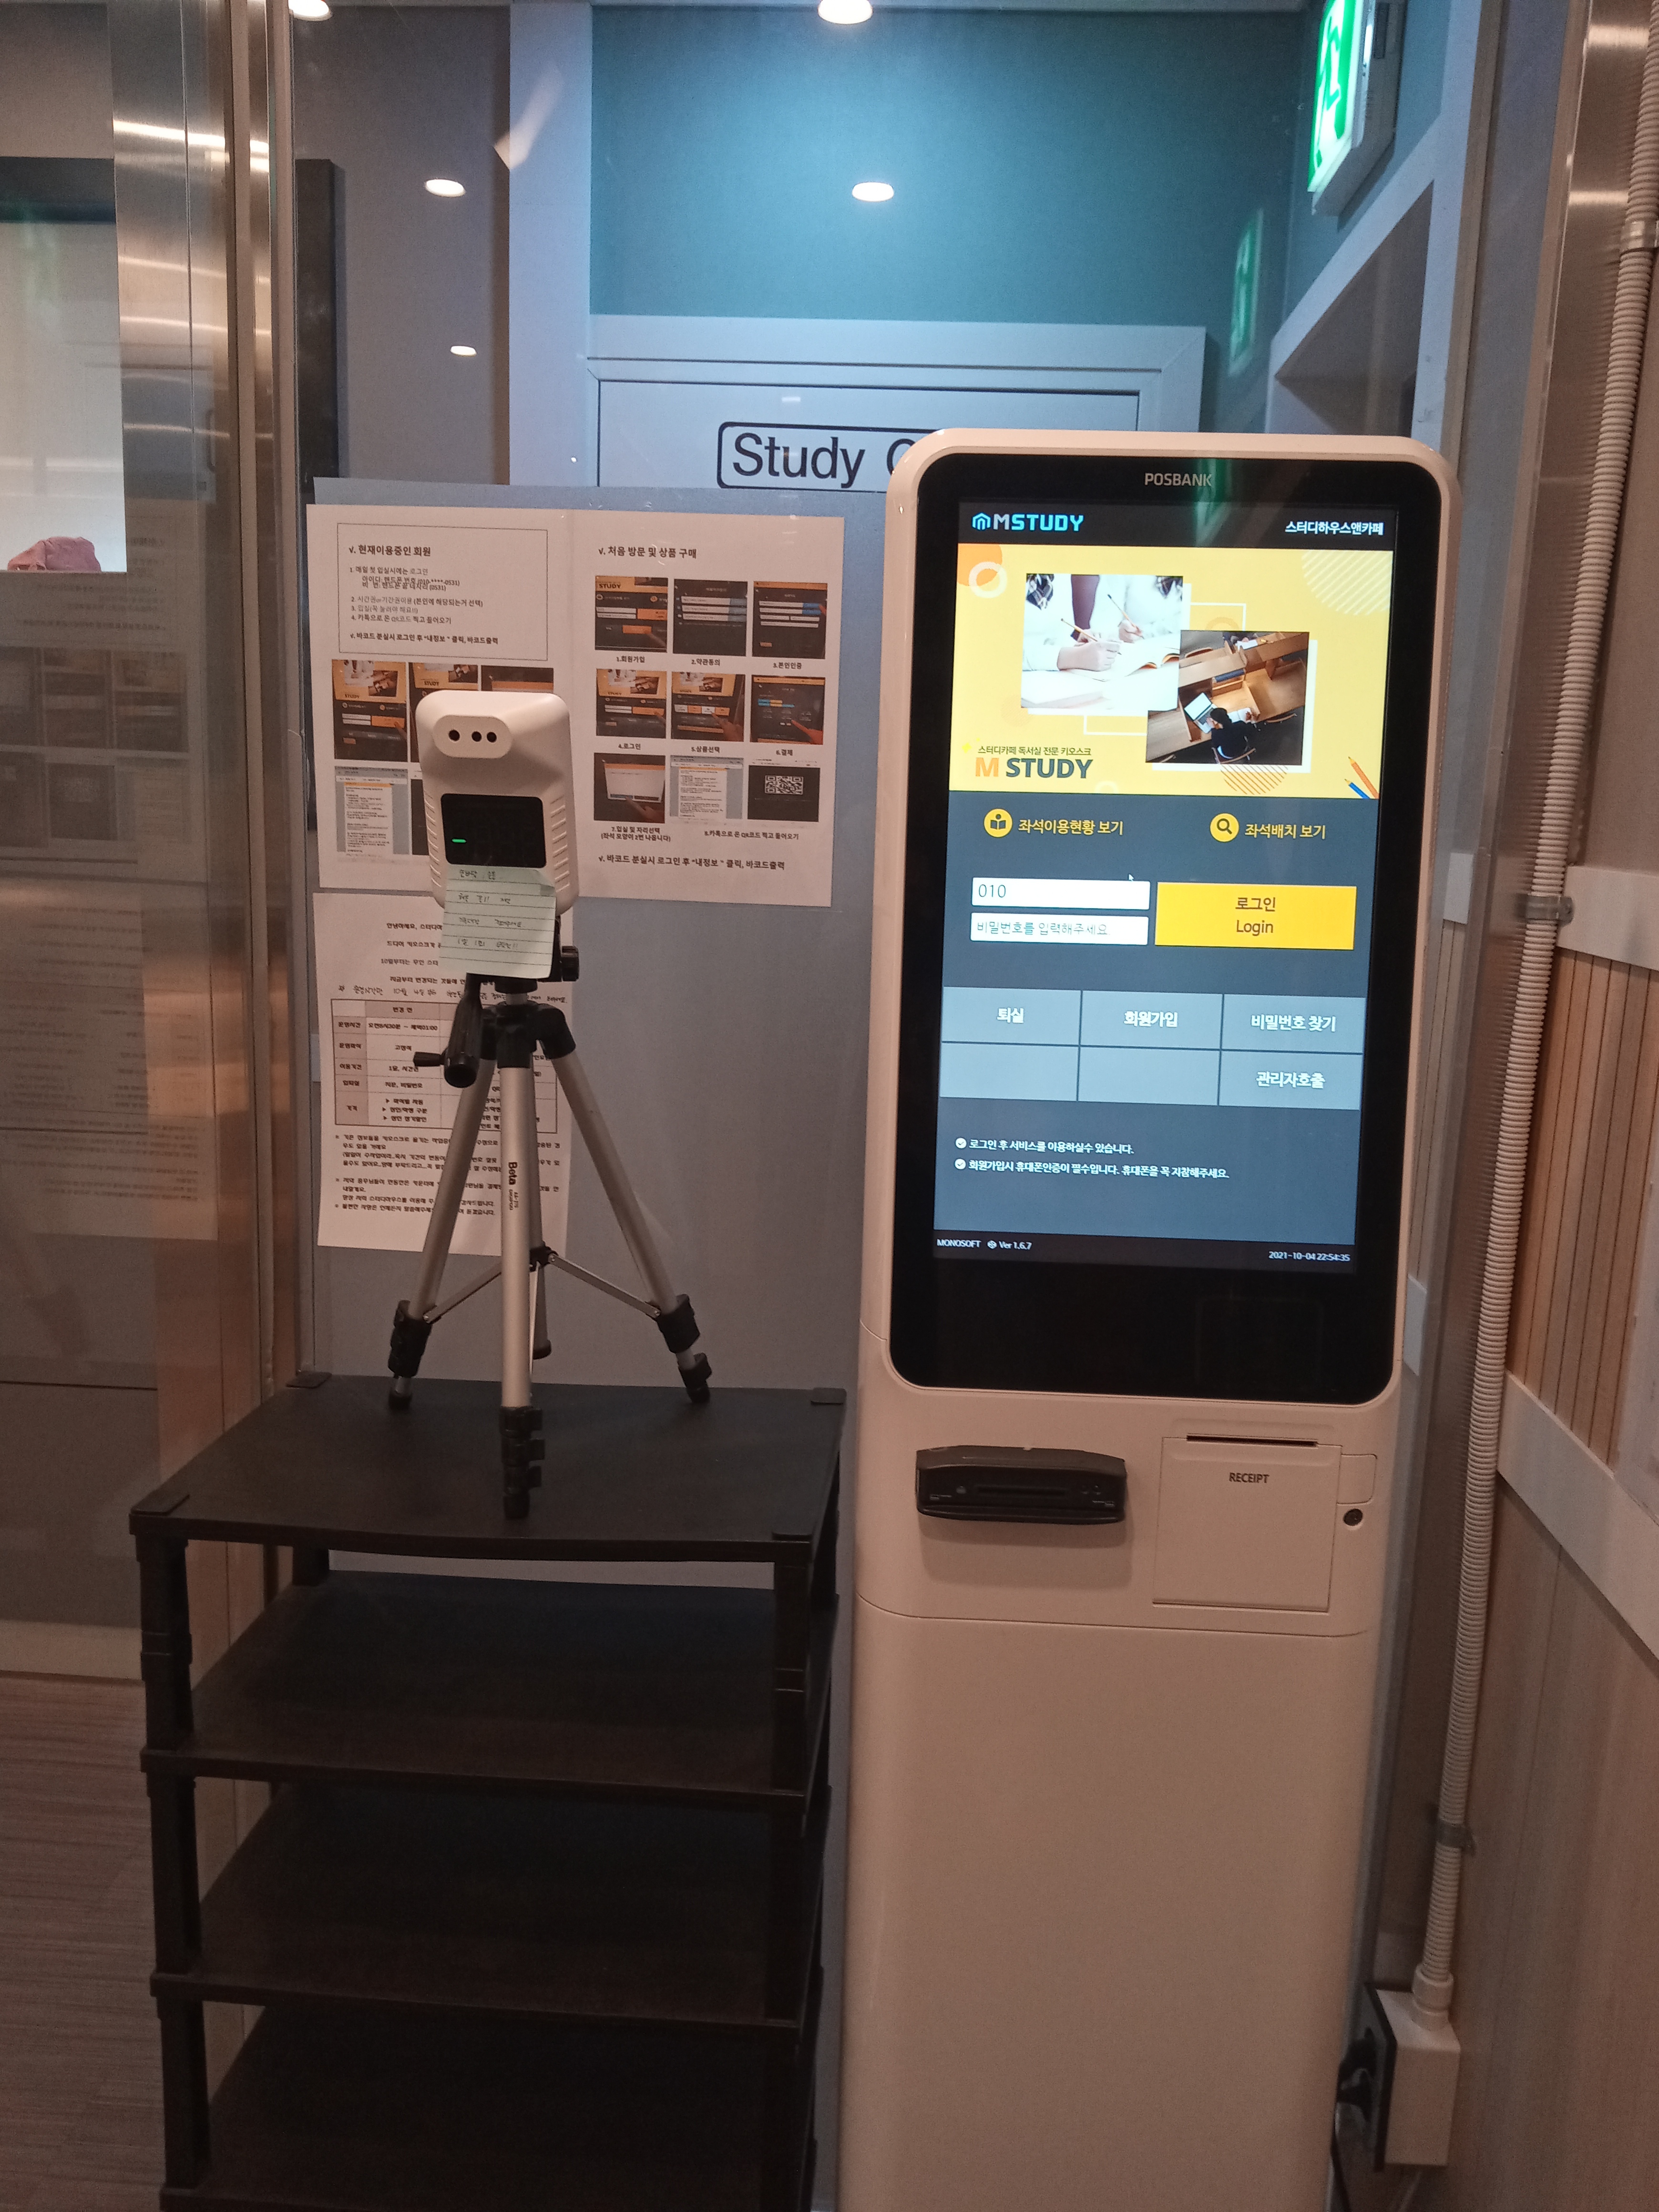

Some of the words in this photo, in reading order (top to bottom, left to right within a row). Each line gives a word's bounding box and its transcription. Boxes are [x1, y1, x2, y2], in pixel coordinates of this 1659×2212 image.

[733, 432, 865, 488] Study
[1145, 473, 1212, 487] POSBANK
[1285, 521, 1384, 535] 스터디하우스앤카페
[358, 544, 411, 556] 현재이용중인
[413, 547, 431, 557] 회원
[608, 546, 625, 557] 처음
[628, 547, 645, 557] 방문
[648, 547, 657, 558] 및
[659, 547, 676, 558] 상품
[679, 548, 697, 559] 구매
[978, 746, 1016, 755] 스터디카페
[1018, 747, 1041, 756] 독서실
[1043, 747, 1059, 756] 전문
[1061, 747, 1091, 756] 키오스크
[975, 757, 999, 777] M
[1006, 758, 1094, 778] STUDY
[1018, 819, 1096, 835] 좌석이용현황
[1097, 821, 1124, 835] 보기
[1244, 824, 1296, 839] 좌석배치
[1300, 825, 1326, 840] 보기
[607, 854, 630, 863] 바코드
[632, 855, 655, 865] 분실시
[657, 857, 681, 866] 로그인
[682, 858, 690, 866] 후
[746, 860, 785, 870] 바코드출력
[978, 884, 1006, 898] 010
[1235, 897, 1276, 911] 로그인
[977, 922, 1034, 935] 비밀번호를
[1237, 920, 1274, 936] Login
[997, 1007, 1024, 1024] 퇴실
[1124, 1010, 1178, 1027] 회원가입
[1251, 1014, 1306, 1031] 비밀번호
[1308, 1015, 1336, 1032] 찾기
[1256, 1071, 1326, 1089] 관리자호출
[969, 1139, 997, 1150] 로그인
[998, 1140, 1009, 1150] 후
[1009, 1140, 1046, 1152] 서비스를
[1048, 1141, 1094, 1153] 이용하실수
[1095, 1143, 1135, 1155] 있습니다.
[969, 1160, 1014, 1172] 회원가입시
[1015, 1161, 1070, 1174] 휴대폰인증이
[1071, 1163, 1120, 1175] 필수입니다.
[1121, 1165, 1159, 1177] 휴대폰을
[1159, 1166, 1170, 1177] 꼭
[1171, 1167, 1230, 1179] 지참해주세요.
[937, 1239, 982, 1248] MONOSOFT
[999, 1240, 1012, 1249] Ver
[1014, 1241, 1032, 1250] 1.6.7
[1269, 1251, 1316, 1260] 2021-10-04
[1316, 1252, 1351, 1261] 22:54:35
[1229, 1471, 1270, 1484] RECEIPT
